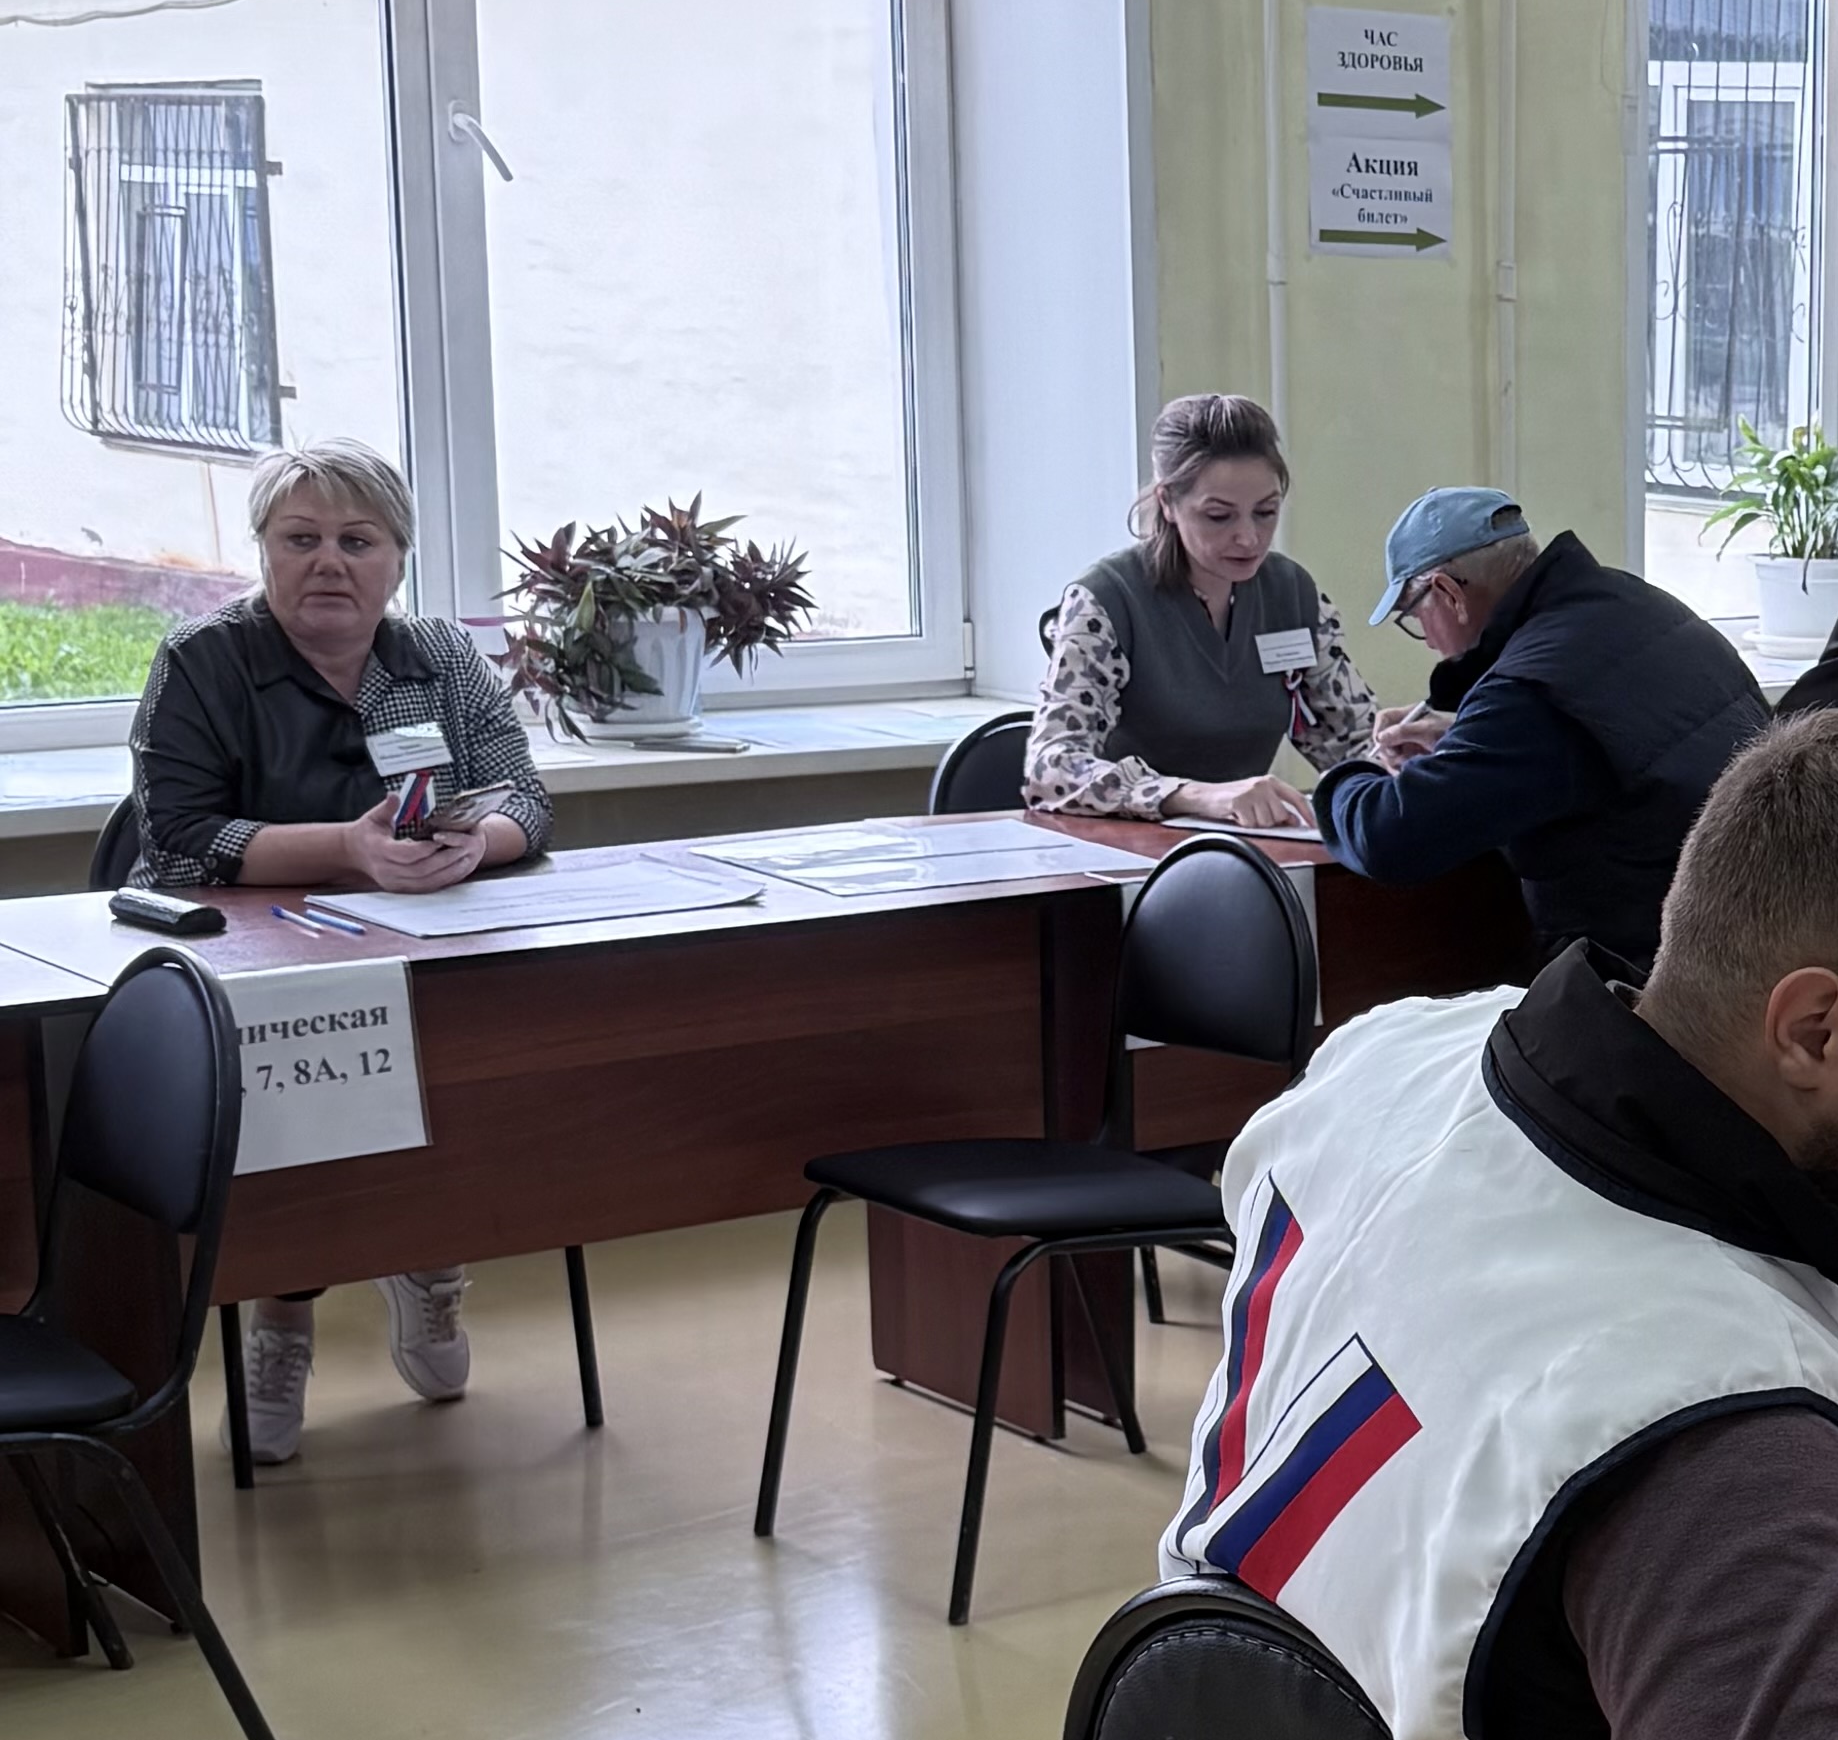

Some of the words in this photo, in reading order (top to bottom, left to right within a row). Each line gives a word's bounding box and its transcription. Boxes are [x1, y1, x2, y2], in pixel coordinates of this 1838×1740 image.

[1363, 28, 1399, 47] ЧАС
[1337, 52, 1424, 73] ЗДОРОВЬЯ
[1346, 152, 1420, 177] Акция
[1331, 183, 1433, 203] «Счастливый
[1357, 208, 1408, 225] билет»
[256, 1064, 285, 1093] 7,
[294, 1058, 348, 1084] 8А,
[359, 1048, 393, 1076] 12
